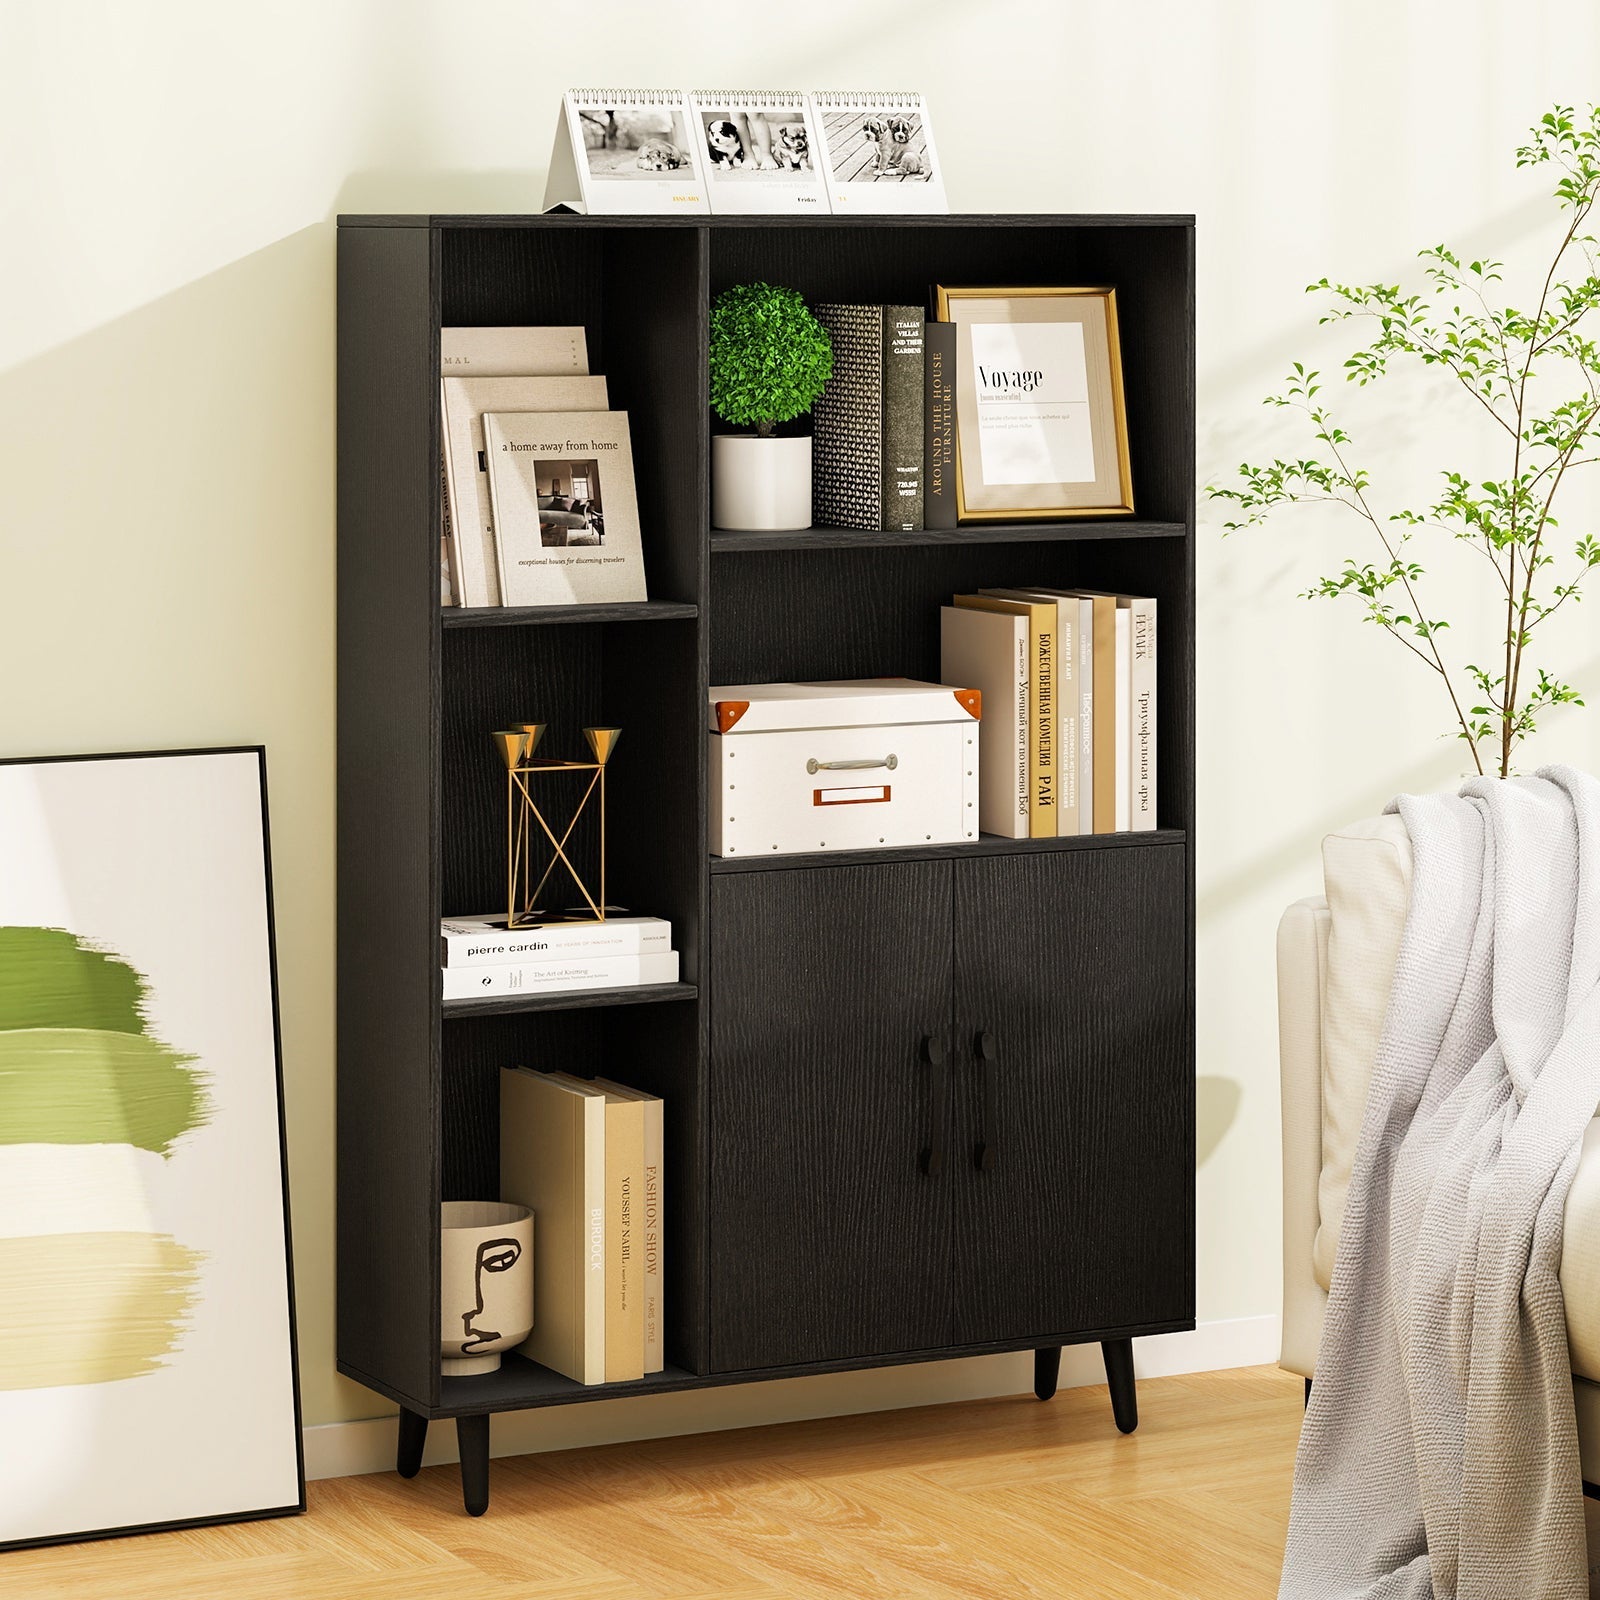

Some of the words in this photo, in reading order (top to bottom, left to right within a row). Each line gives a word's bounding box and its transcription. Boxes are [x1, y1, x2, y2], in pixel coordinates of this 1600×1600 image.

[932, 352, 942, 399] HOUSE
[979, 365, 1043, 392] Voyage
[932, 404, 942, 434] THE
[943, 384, 952, 464] FURNITURE
[502, 443, 508, 451] a
[510, 442, 537, 452] home
[540, 443, 564, 454] away
[566, 440, 589, 451] from
[591, 440, 618, 451] home
[932, 438, 942, 496] AROUND
[518, 557, 548, 567] exceptional
[548, 557, 566, 565] houses
[565, 557, 575, 567] for
[575, 556, 602, 566] discerning
[603, 556, 625, 564] travelers
[1039, 633, 1051, 715] БОЖЕСТВЕННАЯ
[1019, 681, 1029, 726] Уличный
[1039, 717, 1051, 767] КОМЕДИЯ
[1138, 690, 1151, 780] Триумфальная
[1019, 748, 1026, 761] по
[1019, 795, 1029, 815] Боб
[1038, 775, 1055, 806] РАЙ
[1138, 784, 1149, 812] арка
[467, 945, 504, 957] pierre
[509, 941, 548, 953] cardin
[622, 1176, 630, 1227] YOUSSEF
[646, 1166, 656, 1229] FASHION
[591, 1208, 602, 1271] BURDOCK
[622, 1229, 630, 1264] NABIL
[646, 1233, 656, 1276] SHOW
[647, 1297, 655, 1318] PARIS
[647, 1322, 655, 1344] STYLE
